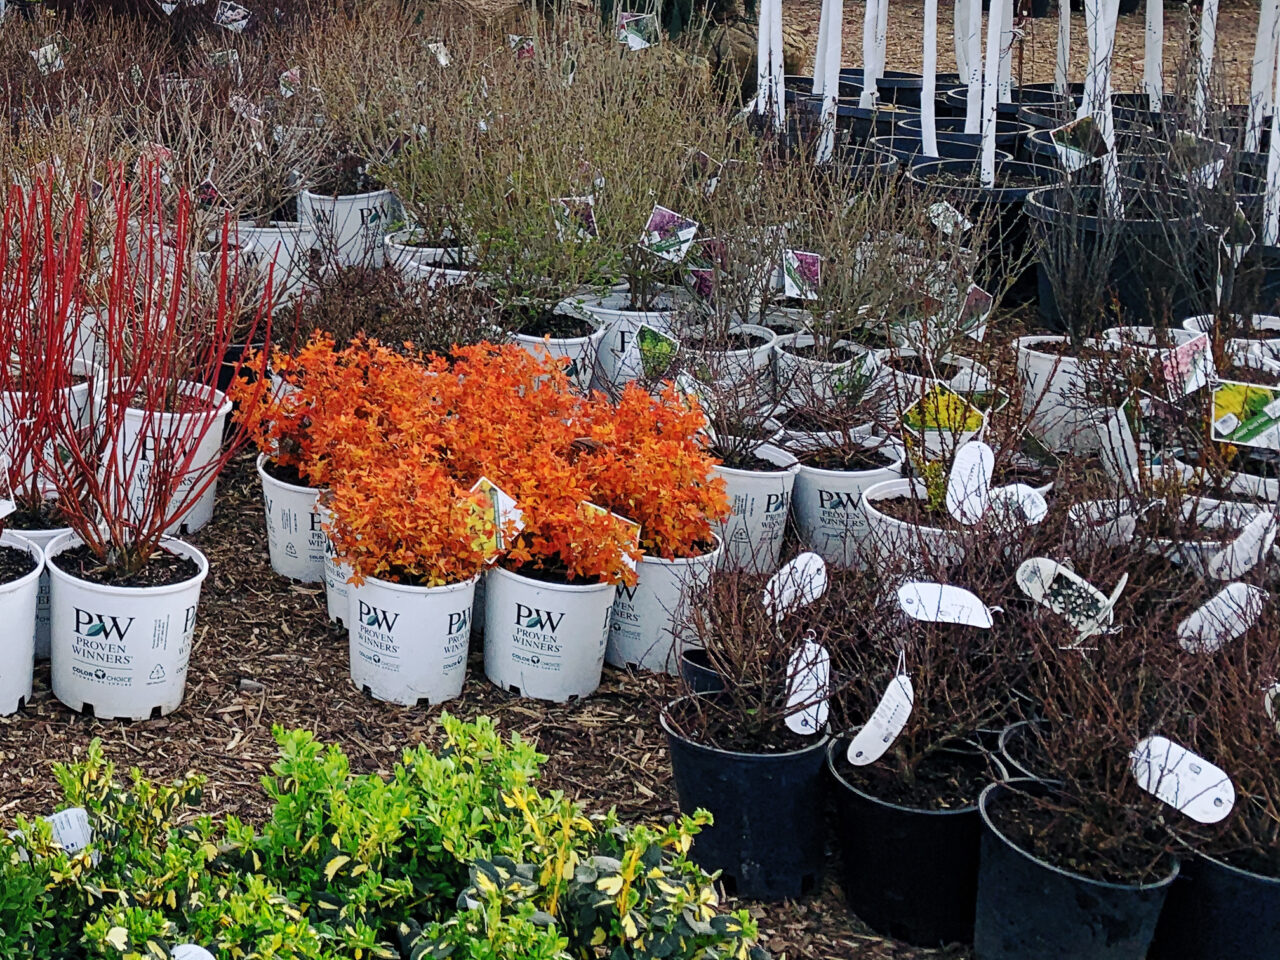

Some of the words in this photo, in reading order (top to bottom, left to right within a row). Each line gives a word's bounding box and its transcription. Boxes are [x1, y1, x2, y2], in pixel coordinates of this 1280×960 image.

[818, 489, 863, 511] PW
[73, 606, 136, 642] PW
[359, 599, 400, 634] PW
[514, 602, 565, 634] PW
[76, 635, 126, 654] PROVEN
[358, 632, 399, 654] WINNERS
[360, 624, 395, 644] PROVEN
[512, 634, 562, 653] WINNERS
[516, 627, 558, 643] PROVEN
[72, 644, 132, 665] WINNERS
[72, 665, 94, 678] COLOR
[106, 675, 132, 683] CHOICE
